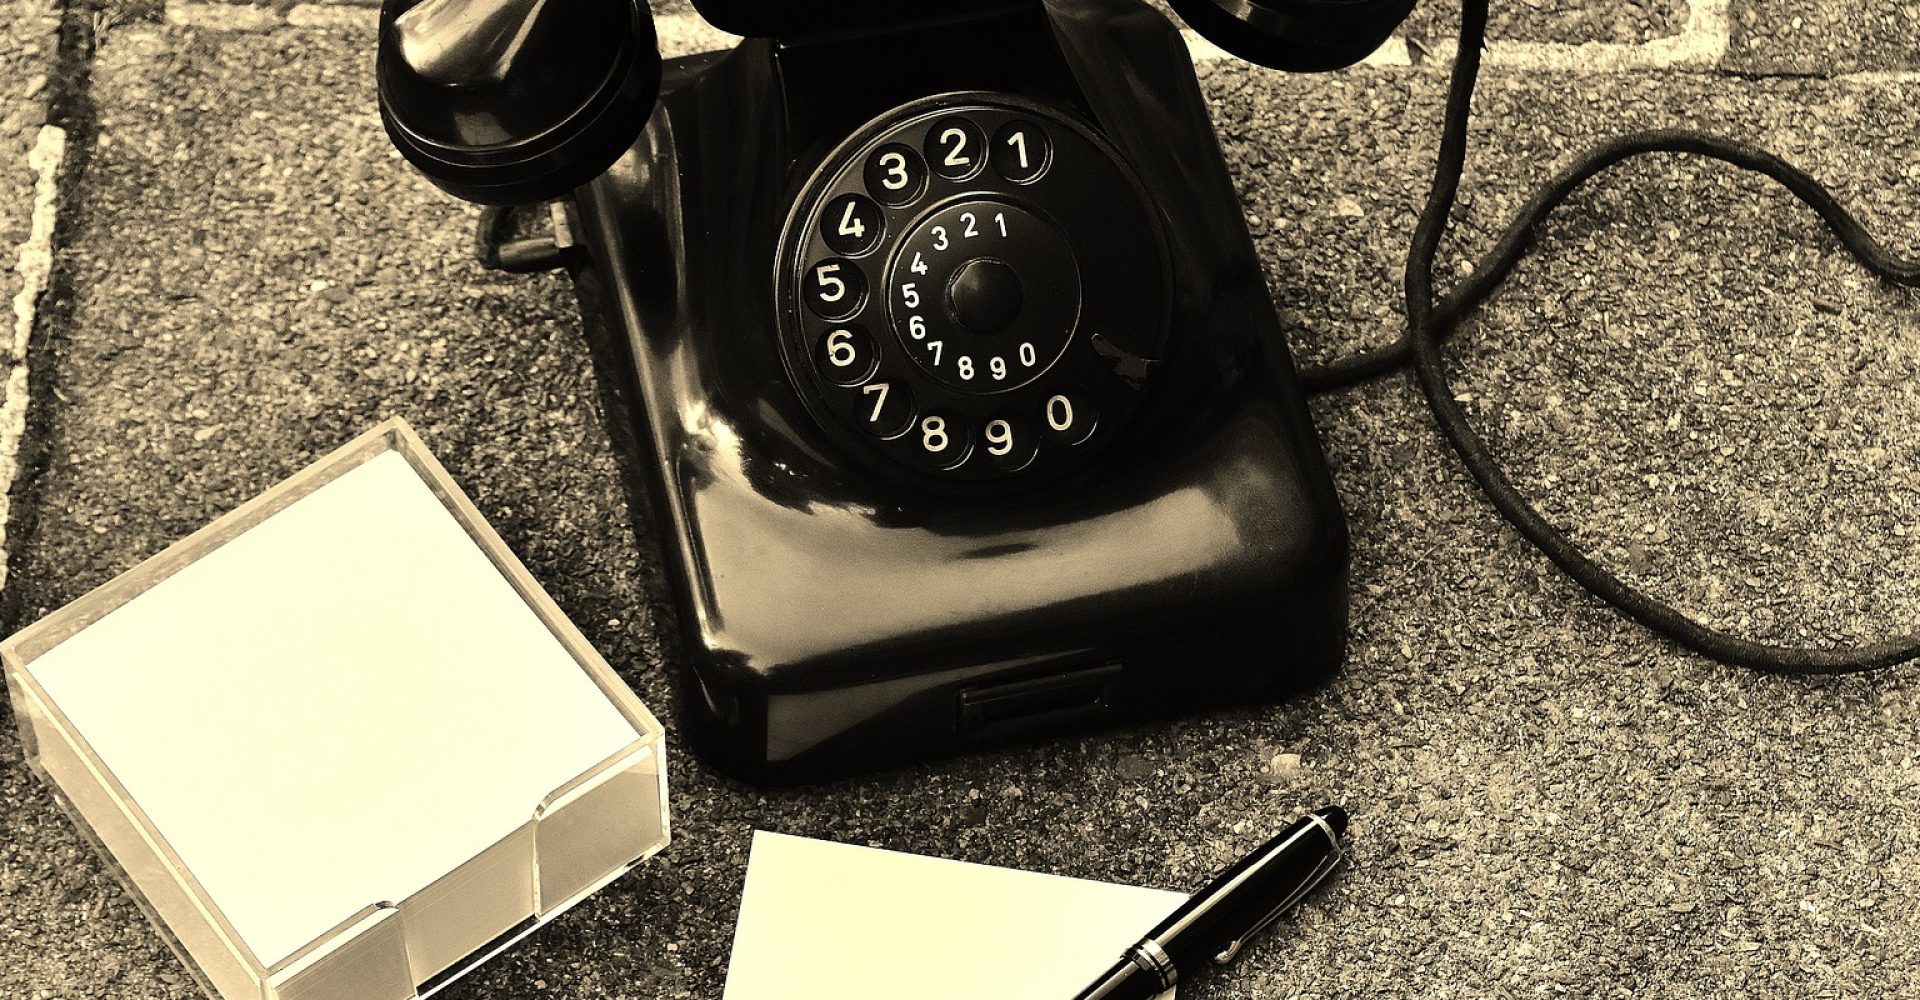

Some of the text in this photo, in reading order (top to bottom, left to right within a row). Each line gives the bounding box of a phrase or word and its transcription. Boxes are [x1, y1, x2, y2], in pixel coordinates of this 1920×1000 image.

[939, 127, 970, 166] 2
[1007, 131, 1029, 169] 1
[879, 152, 909, 190] 3
[838, 201, 865, 238] 4
[959, 211, 979, 239] 2
[994, 212, 1007, 238] 1
[930, 225, 949, 251] 3
[910, 251, 929, 276] 4
[816, 263, 846, 302] 5
[901, 282, 920, 309] 5
[909, 315, 926, 340] 6
[826, 329, 856, 367] 6
[926, 340, 943, 366] 7
[1019, 342, 1036, 367] 0
[957, 355, 975, 381] 8
[989, 356, 1007, 381] 9
[863, 383, 890, 422] 7
[1046, 394, 1074, 431] 0
[921, 415, 949, 452] 8
[985, 419, 1013, 456] 9
